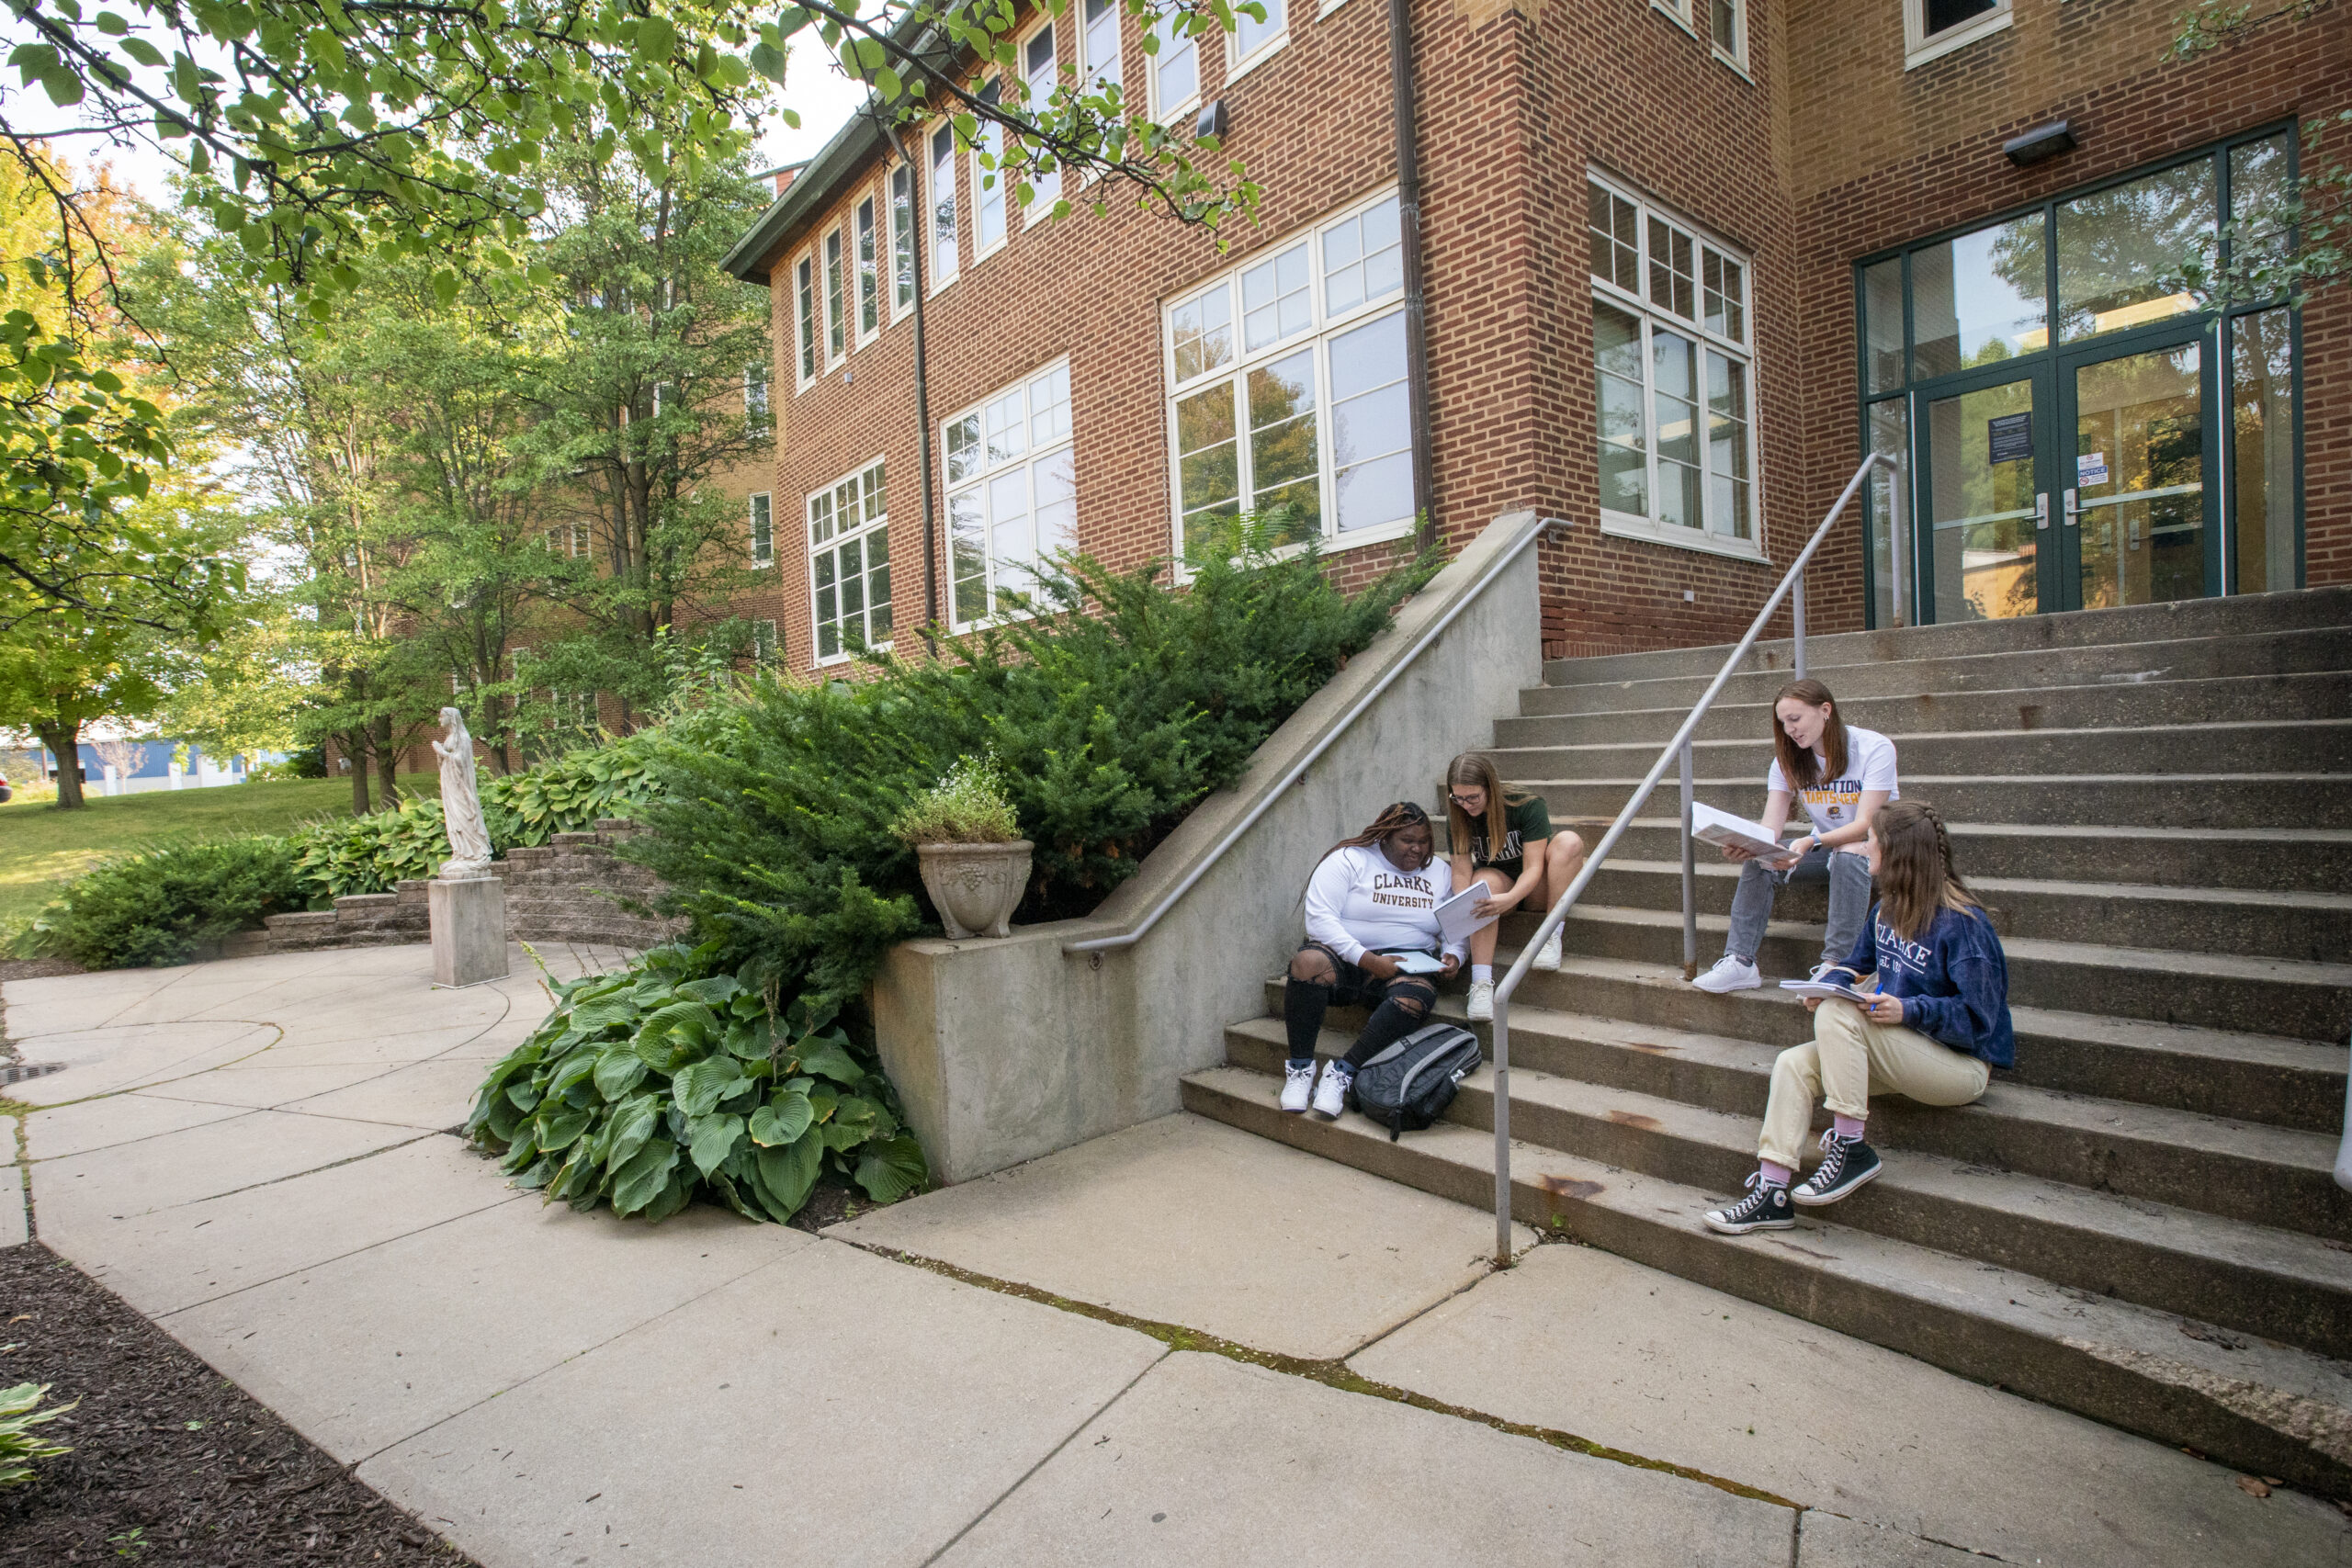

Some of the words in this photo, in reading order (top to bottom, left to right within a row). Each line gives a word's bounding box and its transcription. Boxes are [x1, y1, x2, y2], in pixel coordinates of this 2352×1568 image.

[2079, 468, 2106, 476] NOTICE
[1374, 874, 1434, 896] CLARKE
[1373, 892, 1434, 909] UNIVERSITY
